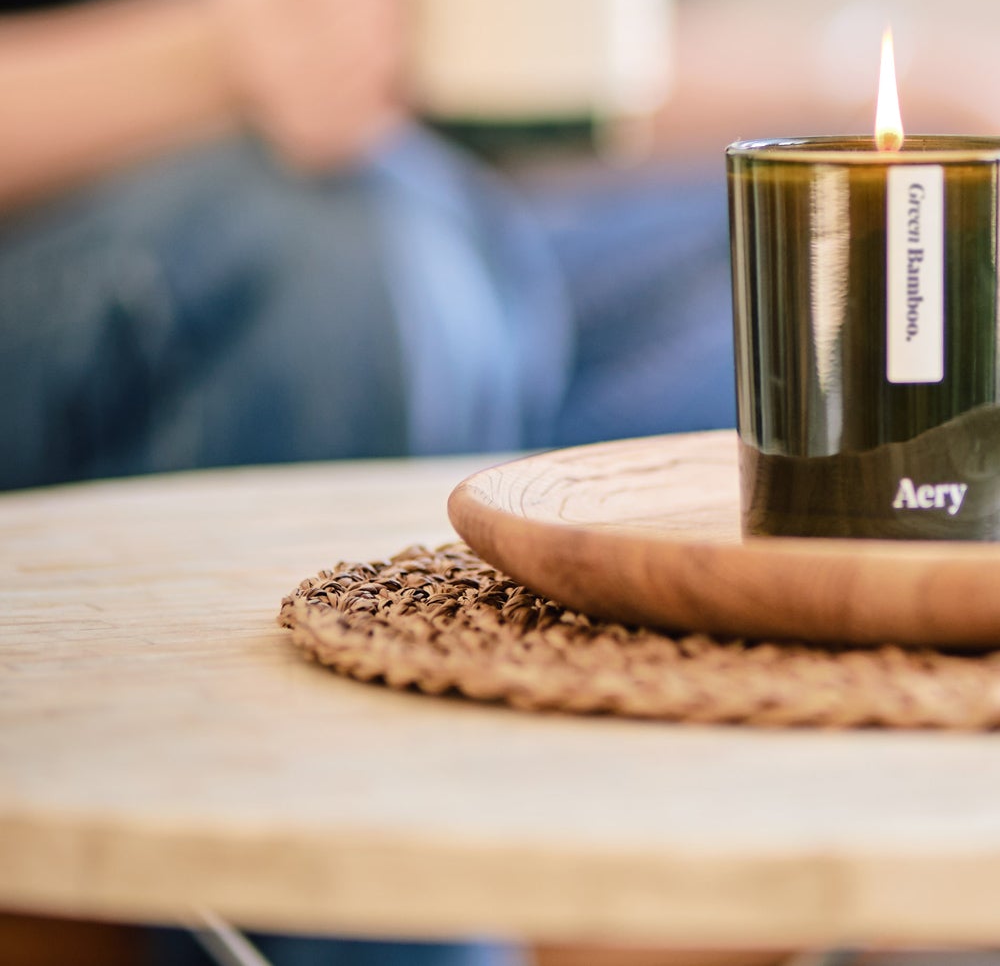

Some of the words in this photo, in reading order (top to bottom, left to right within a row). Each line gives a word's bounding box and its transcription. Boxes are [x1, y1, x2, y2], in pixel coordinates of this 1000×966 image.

[907, 183, 925, 243] Green
[906, 248, 924, 342] Bamboo.
[892, 477, 968, 515] Aery
